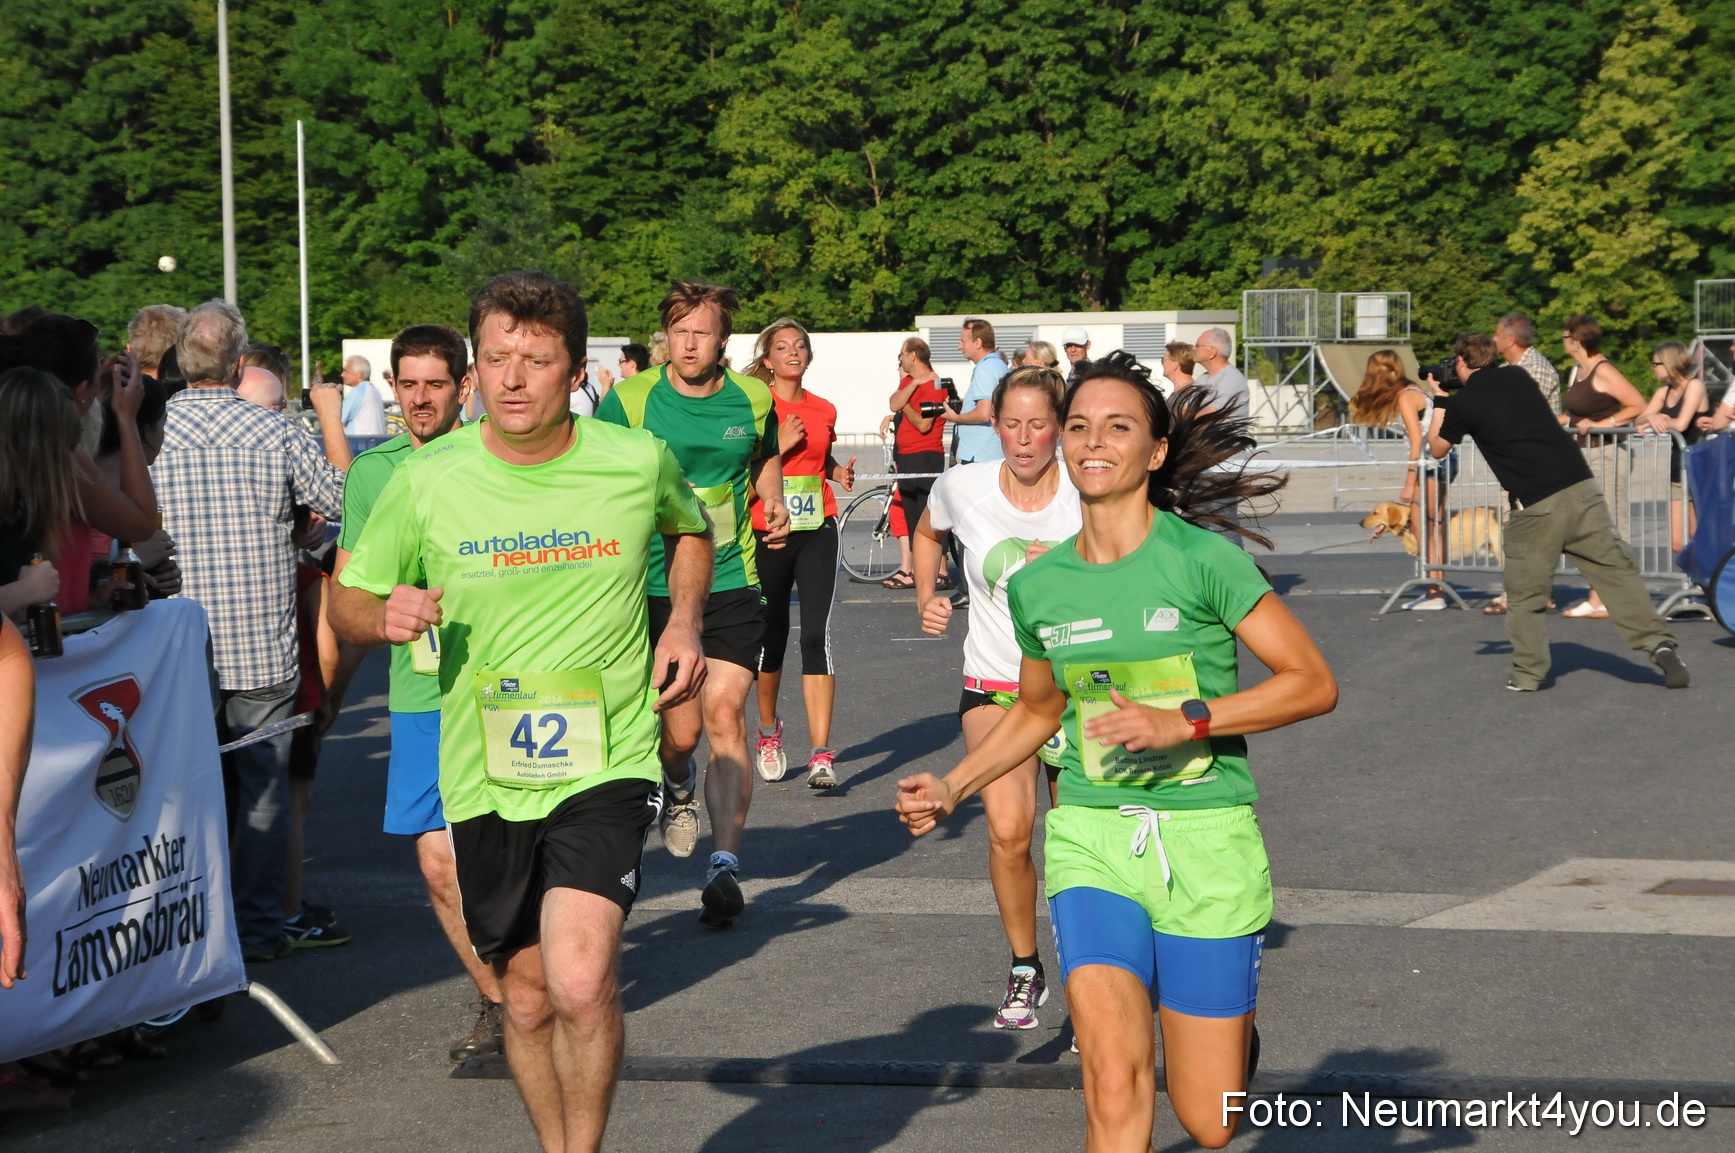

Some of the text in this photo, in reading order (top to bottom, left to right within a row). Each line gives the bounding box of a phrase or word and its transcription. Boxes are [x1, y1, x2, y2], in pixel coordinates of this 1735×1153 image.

[723, 425, 747, 437] AOK
[458, 529, 590, 556] autoladen
[493, 538, 621, 568] neumarkt
[498, 566, 521, 578] groß-
[523, 564, 540, 575] und
[1155, 610, 1177, 620] AOK
[492, 690, 538, 701] firmenlauf
[510, 713, 568, 758] 42
[511, 760, 573, 769] Erfried Damaschke
[1115, 754, 1168, 764] Bettina Lindner
[516, 771, 545, 779] Autoladen
[1129, 767, 1152, 775] Bayern
[108, 781, 135, 808] 1628
[77, 833, 187, 912] Neumarkter
[52, 881, 206, 998] Lammsbräu
